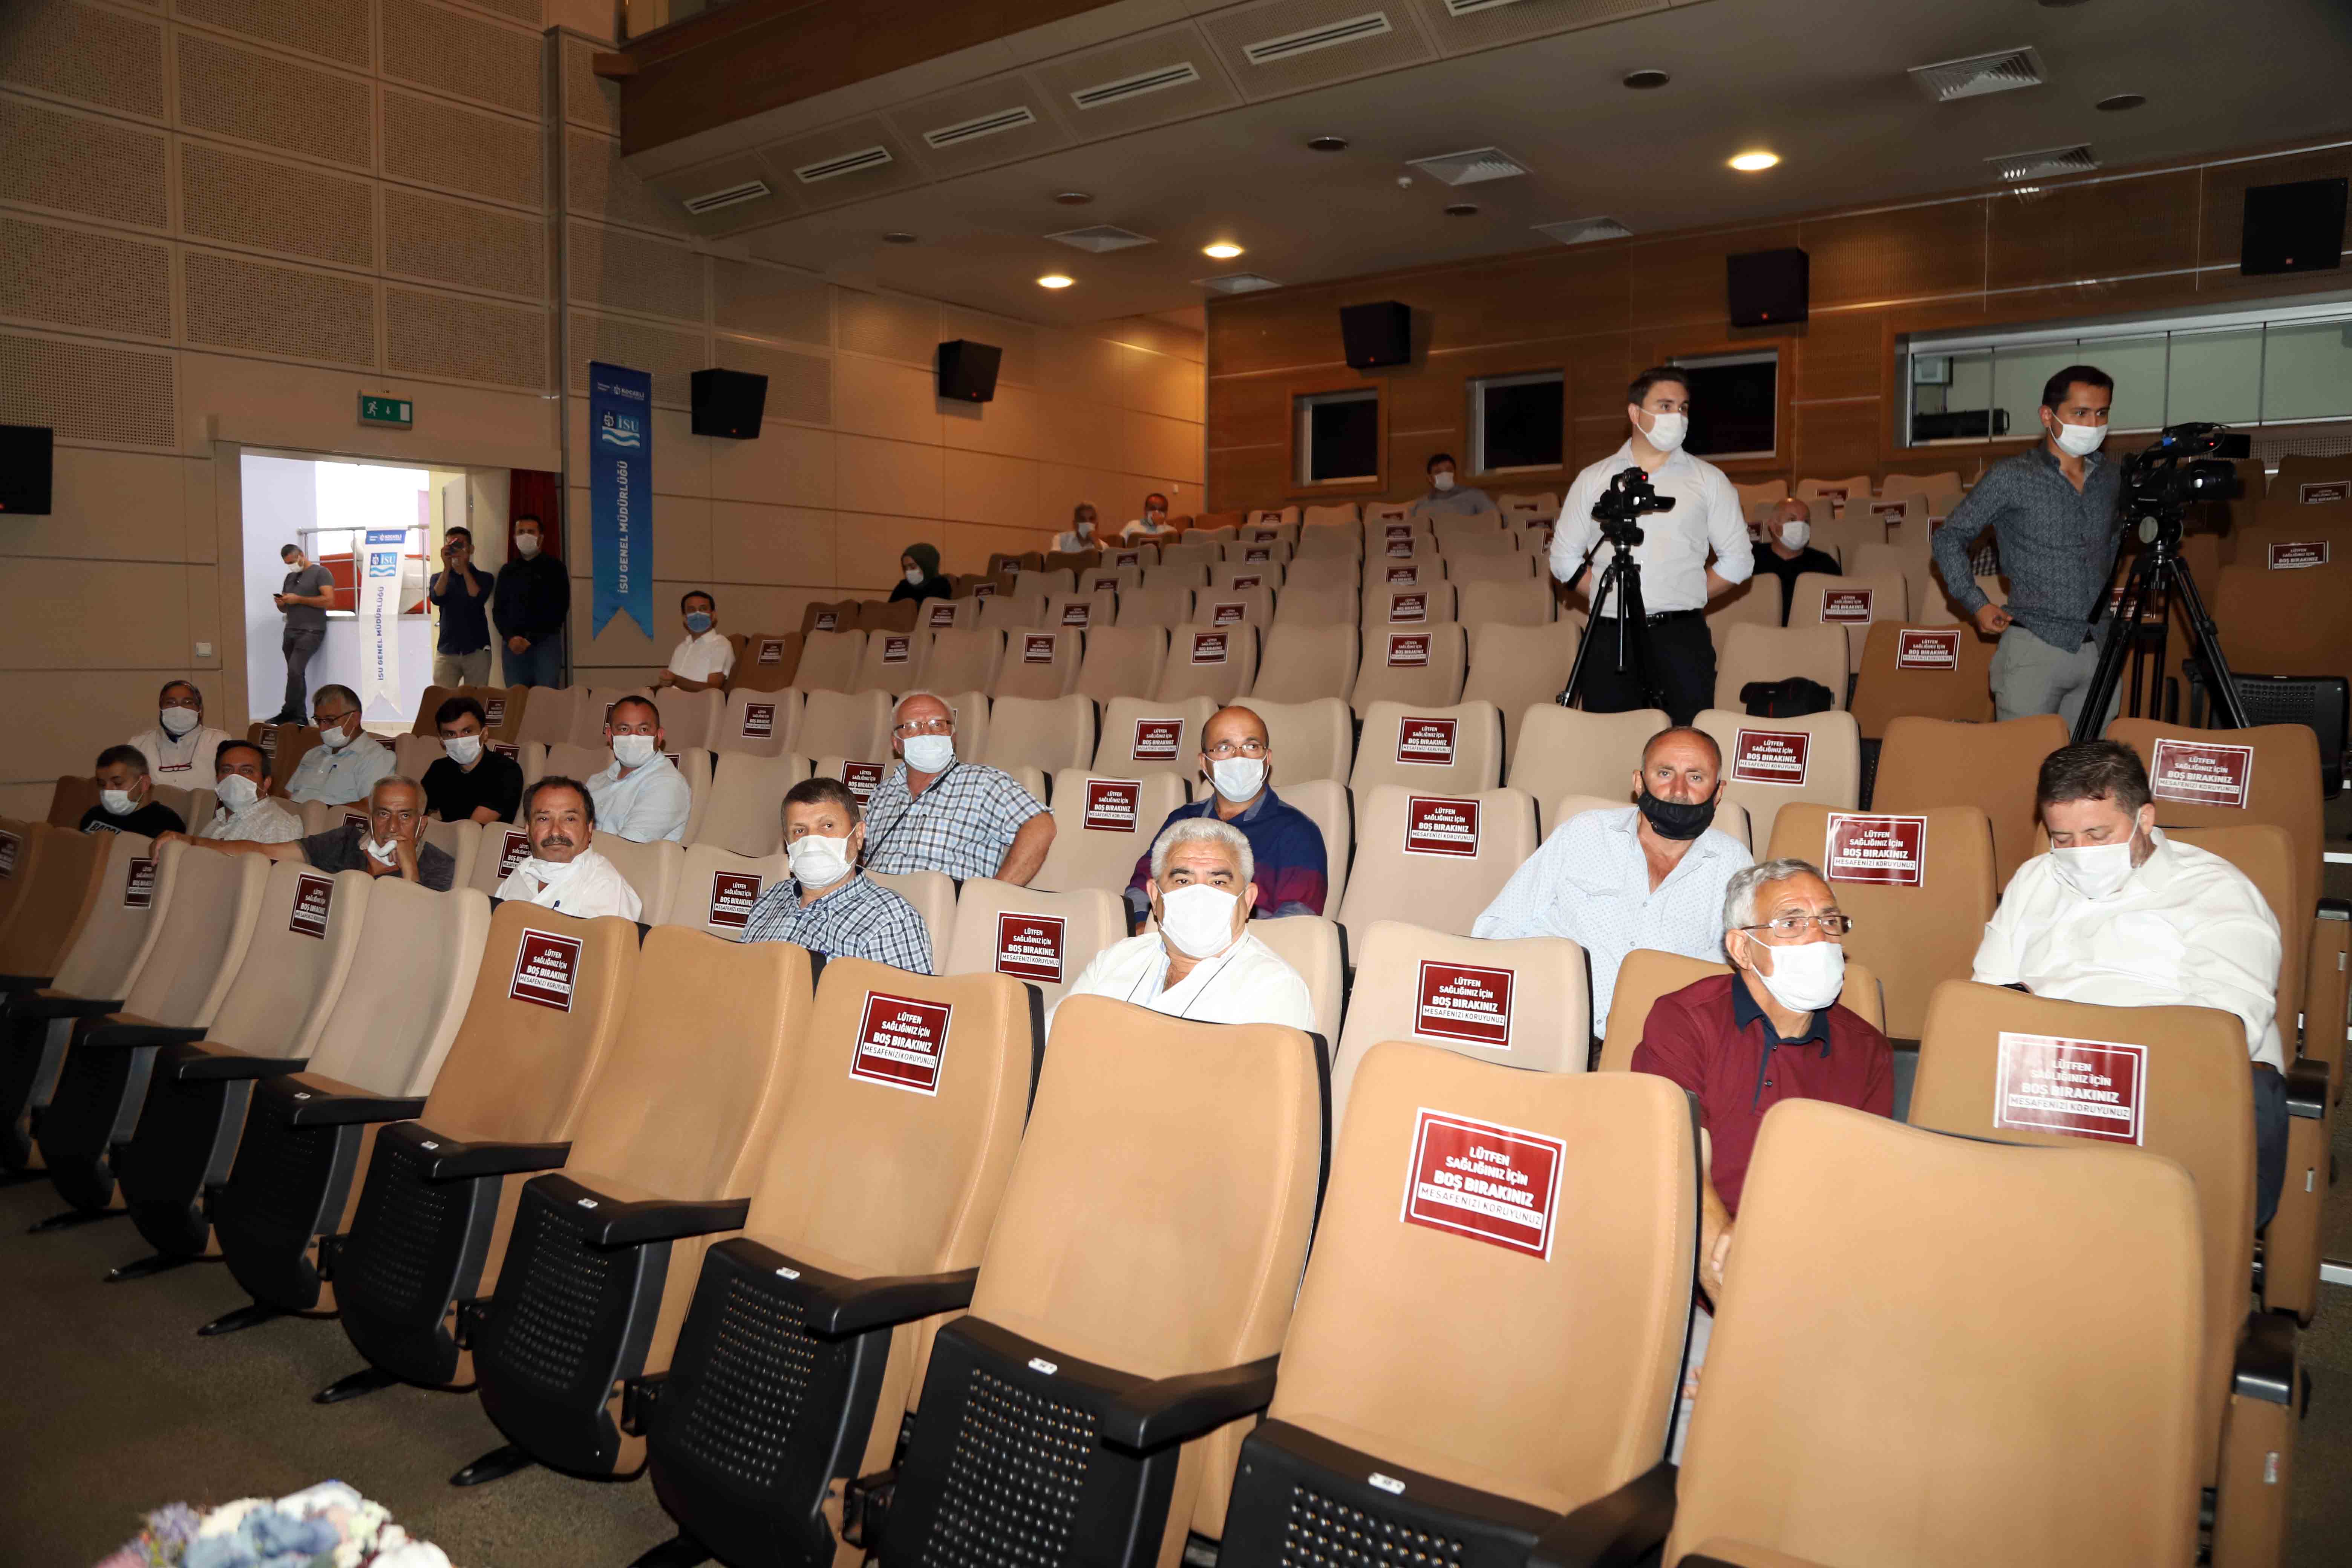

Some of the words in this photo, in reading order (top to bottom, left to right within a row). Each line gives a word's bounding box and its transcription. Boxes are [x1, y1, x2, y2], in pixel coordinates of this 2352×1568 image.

[618, 415, 639, 432] İSU
[617, 461, 628, 532] MÜDÜRLÜĞÜ
[620, 535, 628, 573] GENEL
[617, 575, 628, 593] İSU
[1746, 753, 1761, 762] BOŞ
[1761, 754, 1796, 763] BIRAKINIZ
[2188, 756, 2216, 765] LÜTFEN
[2174, 763, 2213, 772] SAĞLIĞINIZ
[2213, 766, 2228, 774] İÇİN
[2166, 771, 2185, 781] BOŞ
[2187, 773, 2233, 784] BIRAKINIZ
[1093, 804, 1105, 812] BOŞ
[1454, 815, 1465, 824] İÇİN
[1418, 822, 1433, 832] BOŞ
[1434, 823, 1469, 833] BIRAKINIZ
[1850, 838, 1888, 847] SAĞLIĞINIZ
[1889, 839, 1903, 848] İÇİN
[1842, 848, 1861, 859] BOŞ
[1862, 849, 1908, 859] BIRAKINIZ
[724, 888, 745, 896] SAĞLIĞINIZ
[300, 903, 310, 912] BOŞ
[719, 896, 730, 905] BOŞ
[730, 897, 753, 906] BIRAKINIZ
[1024, 927, 1043, 936] LÜTFEN
[1013, 935, 1041, 944] SAĞLIĞINIZ
[1041, 937, 1051, 946] İÇİN
[545, 948, 562, 959] LÜTFEN
[1008, 943, 1022, 955] BOŞ
[1023, 945, 1055, 956] BIRAKINIZ
[533, 956, 559, 968] SAĞLIĞINIZ
[558, 960, 568, 970] İÇİN
[525, 965, 540, 978] BOŞ
[539, 968, 569, 982] BIRAKINIZ
[520, 975, 547, 986] MESAFENİZİ
[546, 982, 570, 992] KORUYUNUZ
[1454, 977, 1481, 987] LÜTFEN
[1439, 985, 1478, 997] SAĞLIĞINIZ
[1479, 989, 1493, 1000] İÇİN
[1431, 995, 1451, 1009] BOŞ
[1452, 998, 1498, 1012] BIRAKINIZ
[897, 1011, 922, 1024] LÜTFEN
[1424, 1008, 1464, 1018] MESAFENİZİ
[1465, 1013, 1504, 1024] KORUYUNUZ
[882, 1020, 917, 1035] SAĞLIĞINIZ
[917, 1026, 931, 1038] İÇİN
[871, 1032, 891, 1047] BOŞ
[891, 1035, 933, 1053] BIRAKINIZ
[864, 1045, 901, 1058] MESAFENİZİ
[901, 1053, 935, 1066] KORUYUNUZ
[2052, 1059, 2092, 1072] LÜTFEN
[2030, 1069, 2089, 1084] SAĞLIĞINIZ
[2090, 1074, 2111, 1087] İÇİN
[2020, 1082, 2048, 1098] BOŞ
[2050, 1085, 2119, 1103] BIRAKINIZ
[2010, 1096, 2069, 1110] MESAFENİZİ
[2070, 1104, 2129, 1118] KORUYUNUZ
[1469, 1147, 1511, 1166] LÜTFEN
[1446, 1156, 1505, 1180] SAĞLIĞINIZ
[1506, 1169, 1528, 1185] İÇİN
[1432, 1170, 1462, 1192] BOŞ
[1464, 1178, 1534, 1207] BIRAKINIZ
[1422, 1185, 1482, 1208] MESAFENİZİ
[1483, 1202, 1541, 1225] KORUYUNUZ
